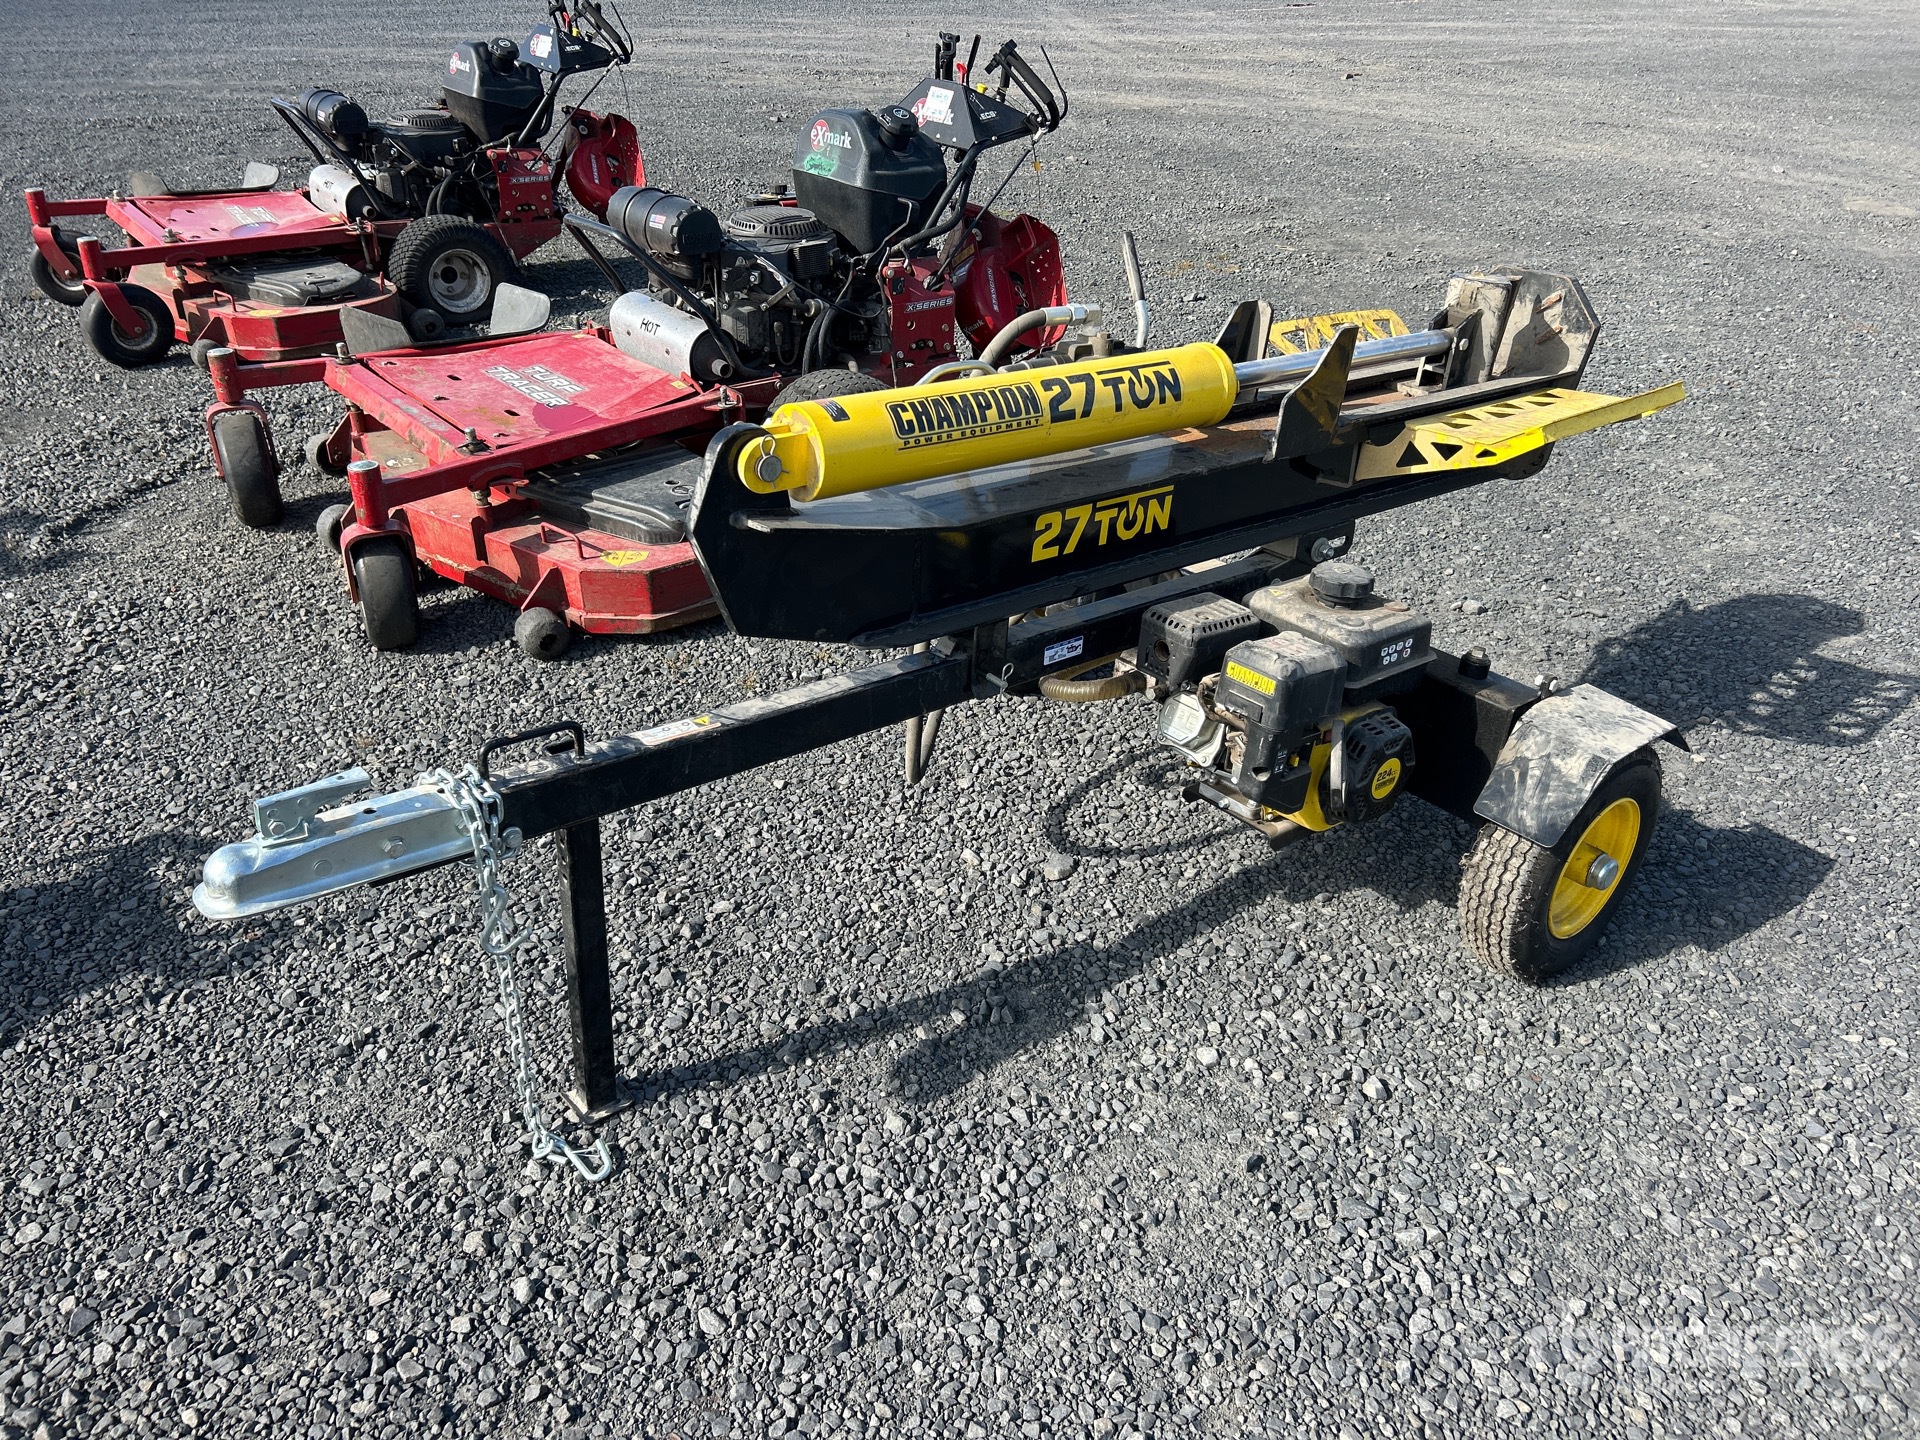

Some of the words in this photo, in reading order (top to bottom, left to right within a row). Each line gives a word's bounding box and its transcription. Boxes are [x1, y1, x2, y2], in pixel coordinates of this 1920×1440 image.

[640, 317, 661, 336] HOT
[485, 366, 571, 408] TRACER
[520, 366, 585, 393] TURF
[889, 384, 1041, 436] CHAMPION
[1040, 373, 1095, 423] 27
[1099, 361, 1182, 413] TON
[903, 433, 953, 447] POWER
[960, 418, 1040, 437] EQUIPMENT
[1031, 504, 1093, 563] 27
[1095, 485, 1174, 546] TON
